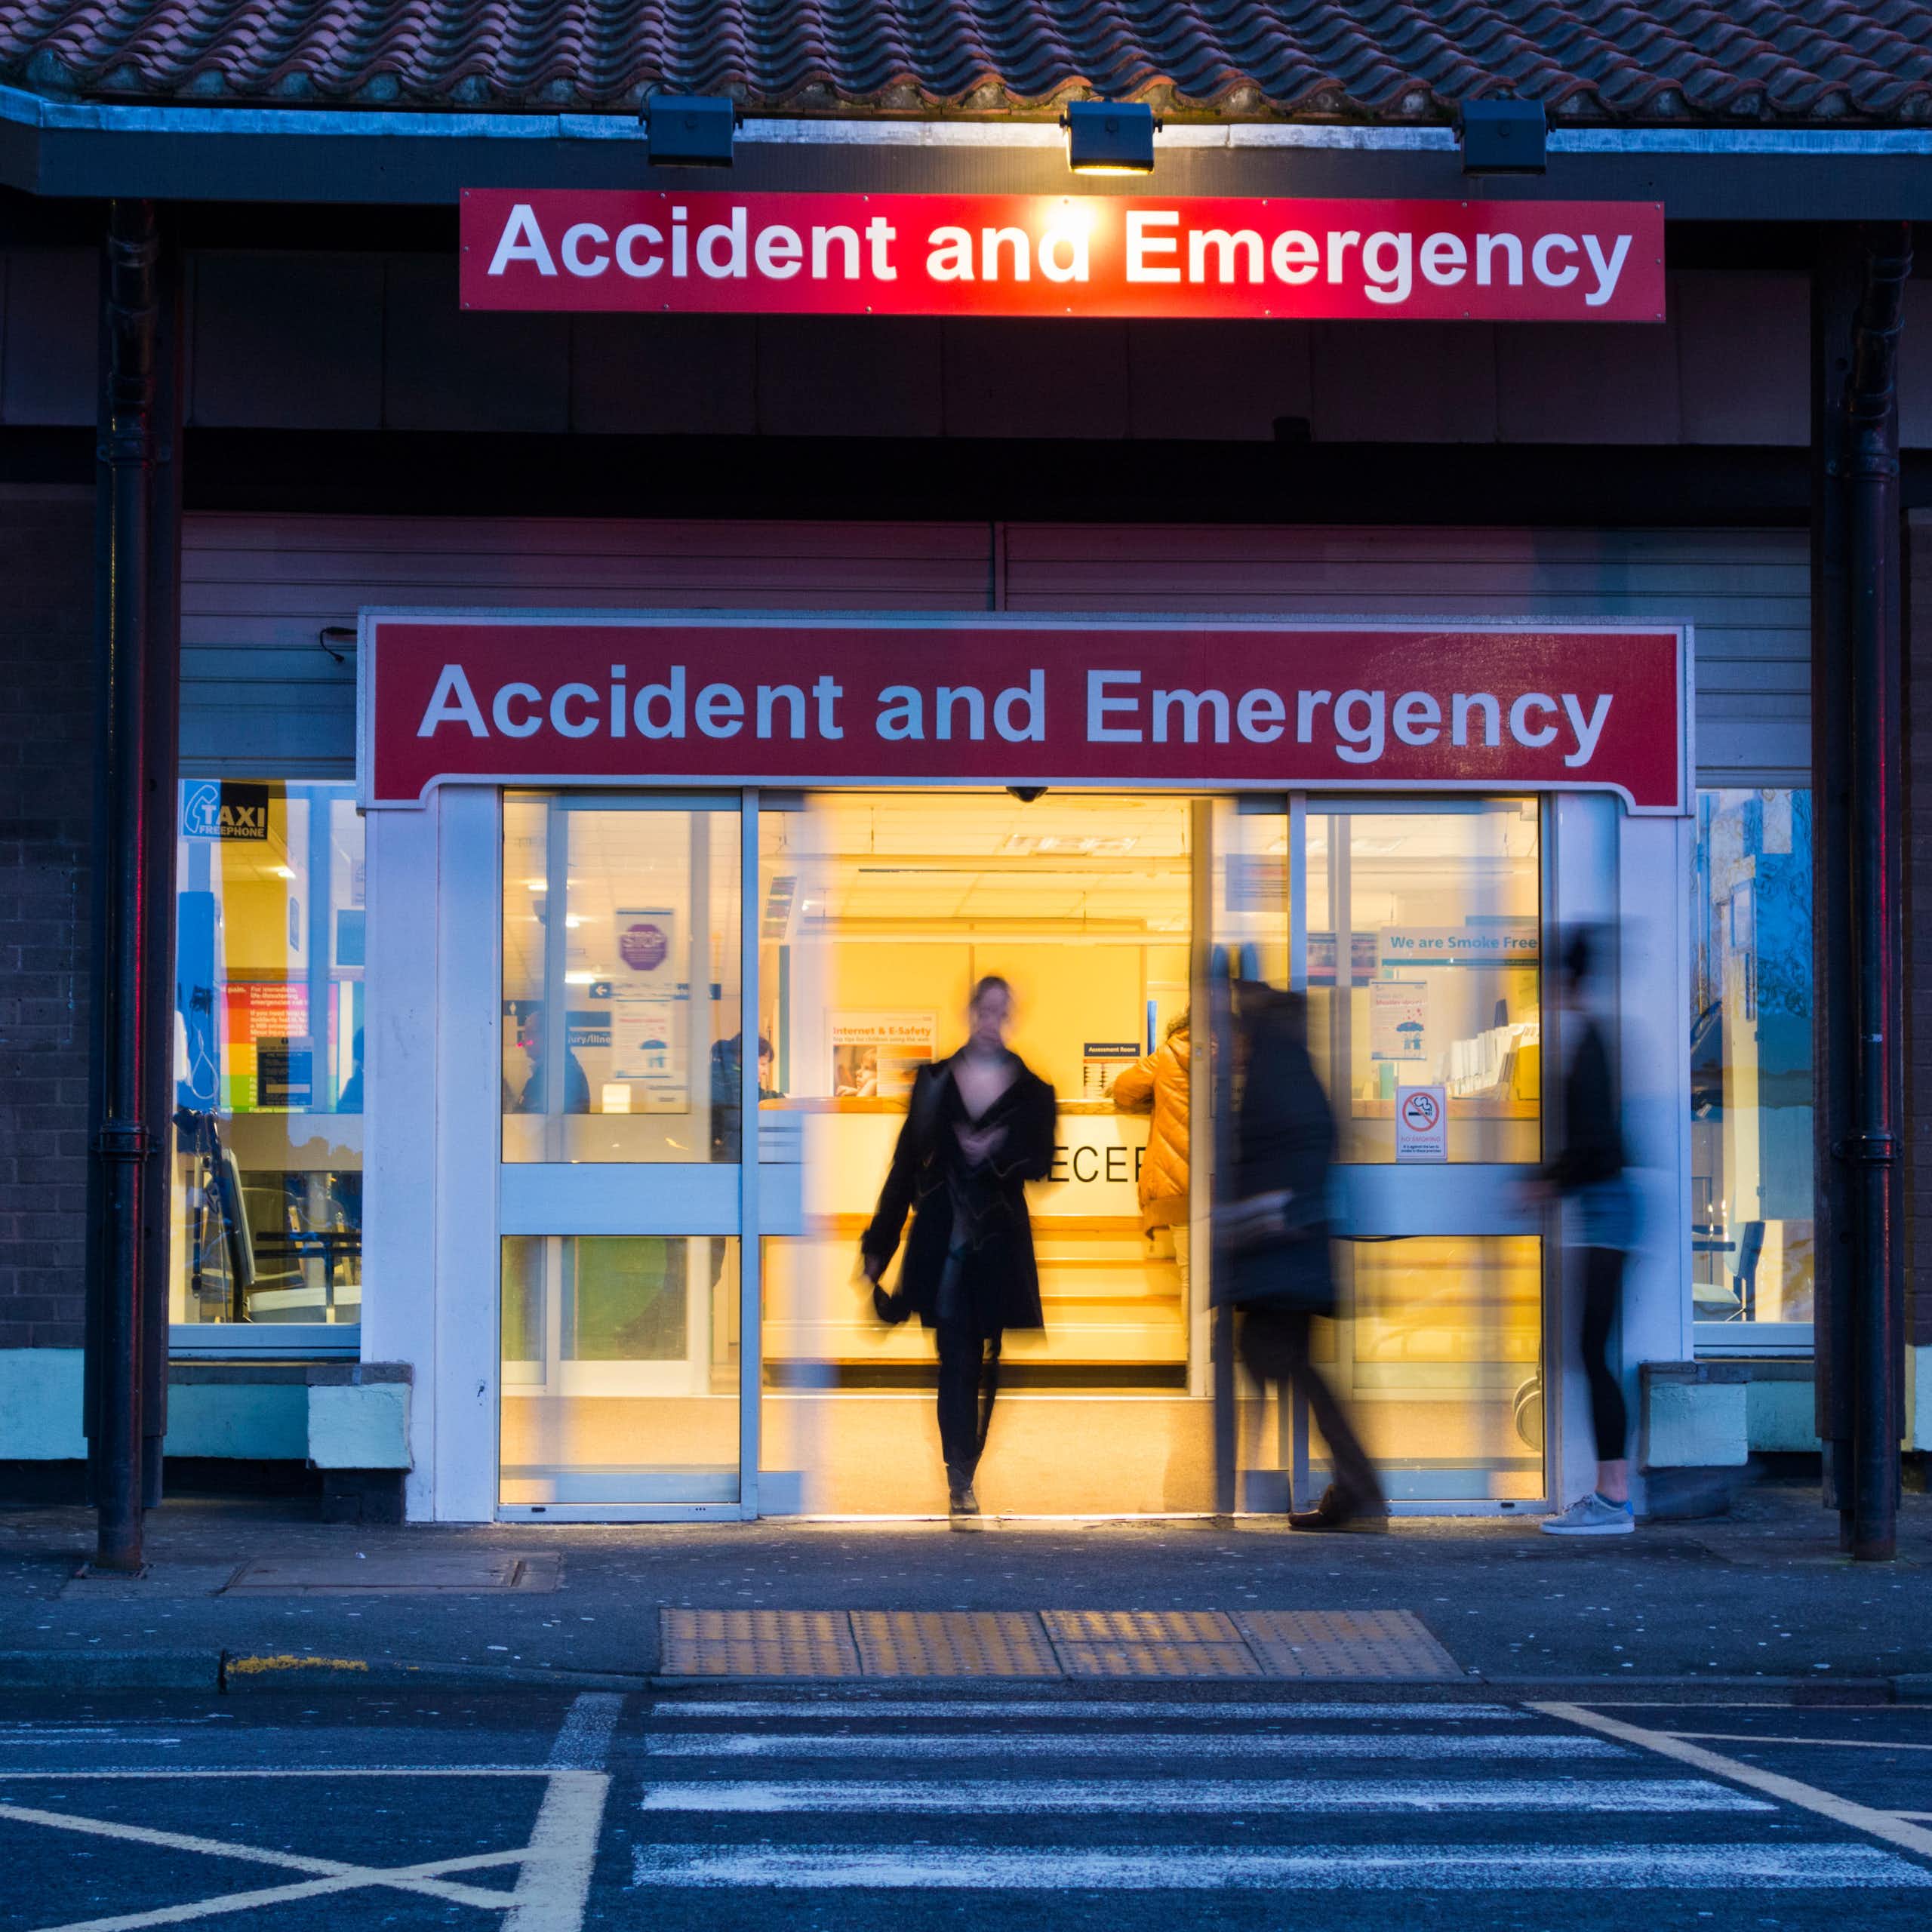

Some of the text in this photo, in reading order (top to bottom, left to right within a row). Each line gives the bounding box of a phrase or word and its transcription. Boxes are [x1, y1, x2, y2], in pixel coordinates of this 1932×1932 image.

[488, 201, 1633, 306] Accident and Emergency
[417, 664, 1614, 768] Accident and Emergency
[202, 804, 265, 827] TAXI
[199, 825, 264, 837] FREEPHONE
[1390, 936, 1537, 949] We are Smoke Free
[832, 1026, 875, 1035] Internet
[889, 1026, 931, 1036] E-Safety
